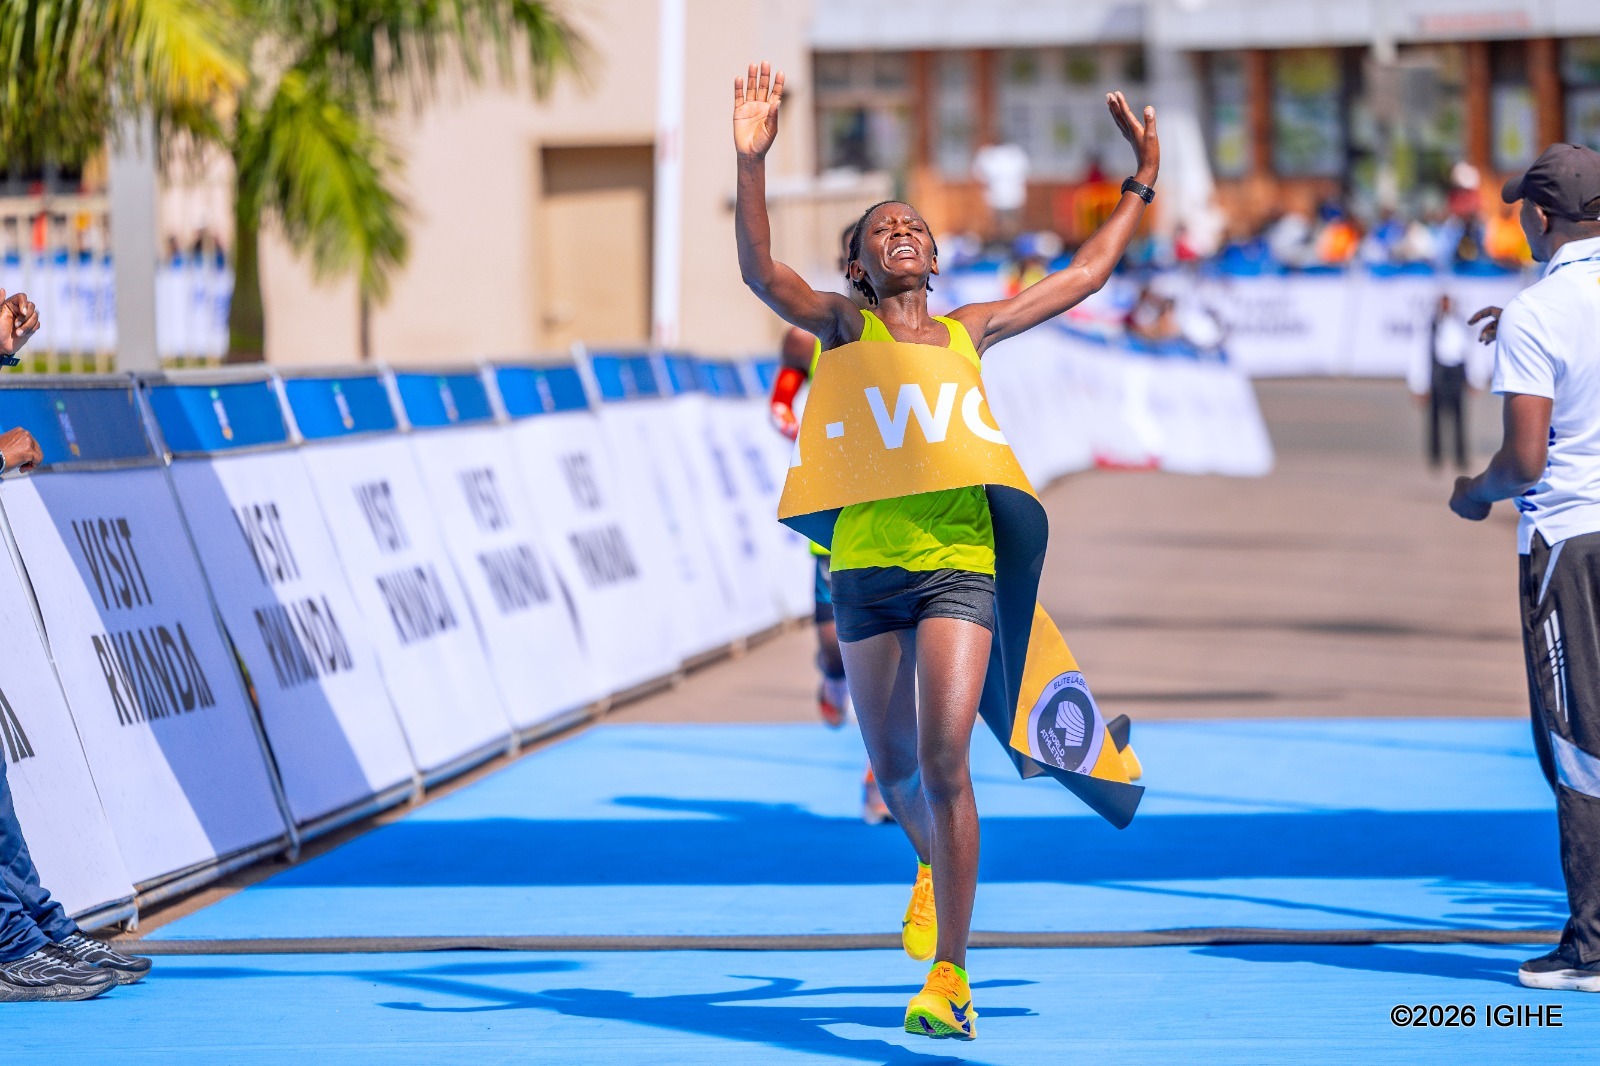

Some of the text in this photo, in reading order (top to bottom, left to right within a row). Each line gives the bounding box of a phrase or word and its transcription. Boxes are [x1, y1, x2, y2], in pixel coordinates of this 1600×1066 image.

[71, 517, 152, 610] VISIT
[232, 503, 300, 586] VISIT
[91, 621, 215, 727] RWANDA
[253, 593, 353, 690] RWANDA
[1053, 676, 1071, 690] ELITE
[1048, 727, 1065, 757] WORLD
